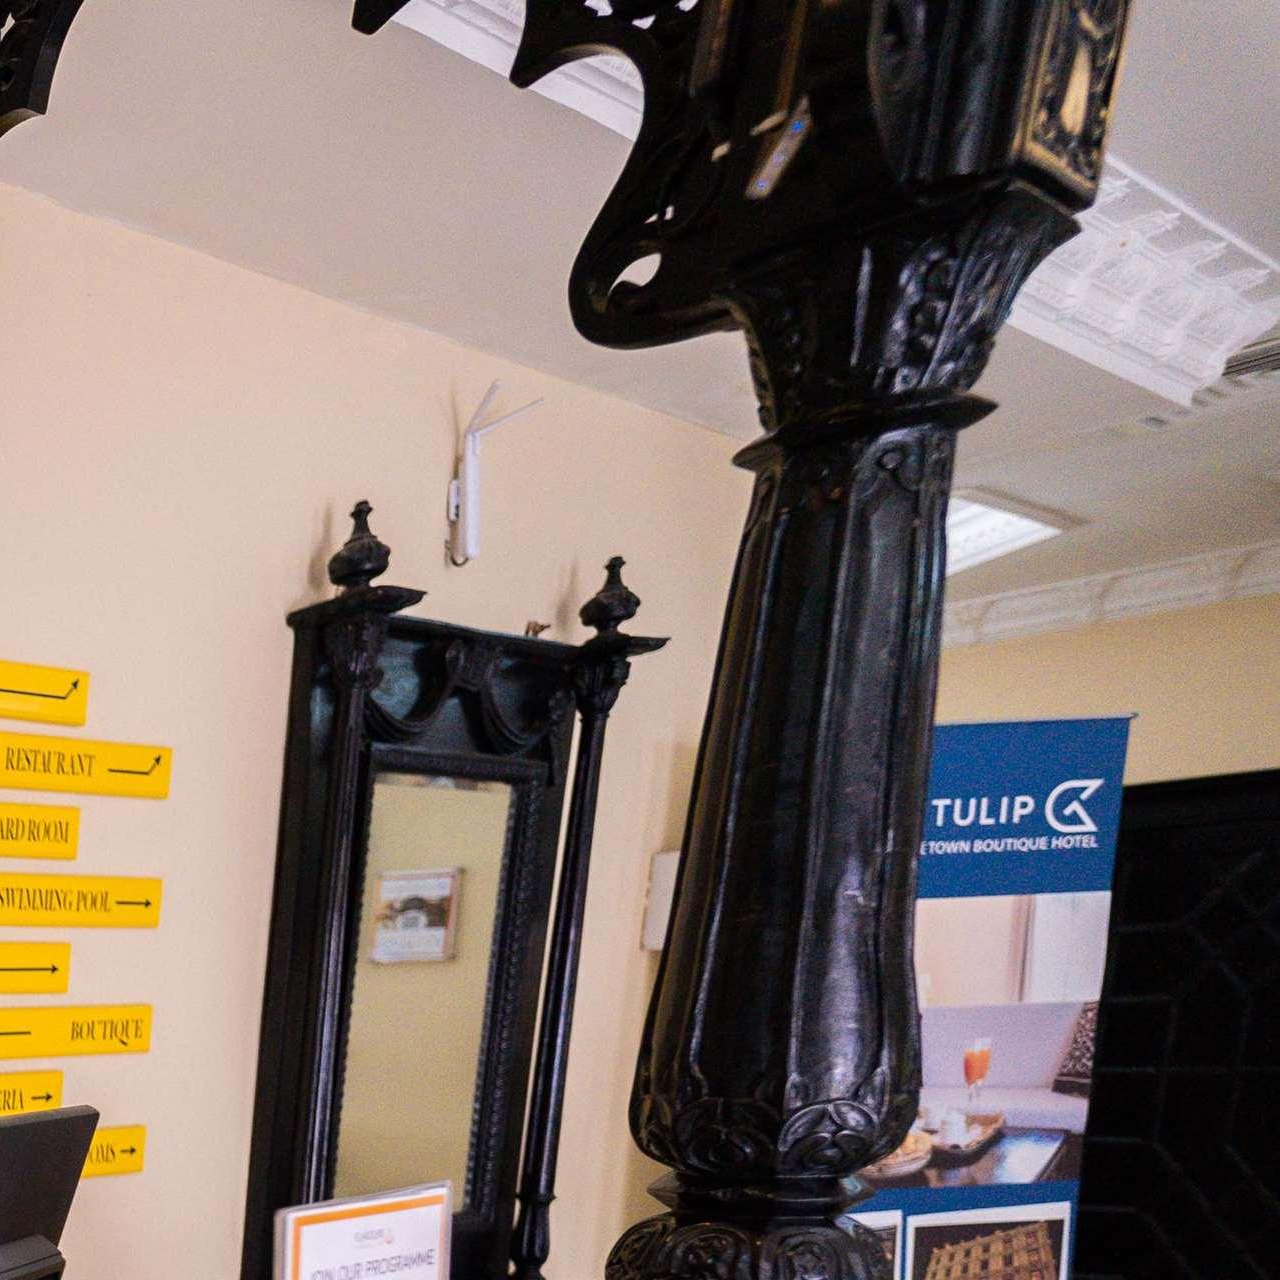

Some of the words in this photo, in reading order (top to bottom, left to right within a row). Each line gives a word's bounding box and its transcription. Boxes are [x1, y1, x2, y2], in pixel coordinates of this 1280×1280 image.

[5, 746, 96, 777] RESTAURANT
[931, 795, 1034, 828] TULIP
[929, 840, 971, 855] TOWN
[973, 836, 1048, 853] BOUTIQUE
[1051, 833, 1099, 849] HOTEL
[76, 890, 112, 912] POOL
[70, 1019, 143, 1047] BOUTIQUE
[365, 1248, 435, 1274] PROGRAMME
